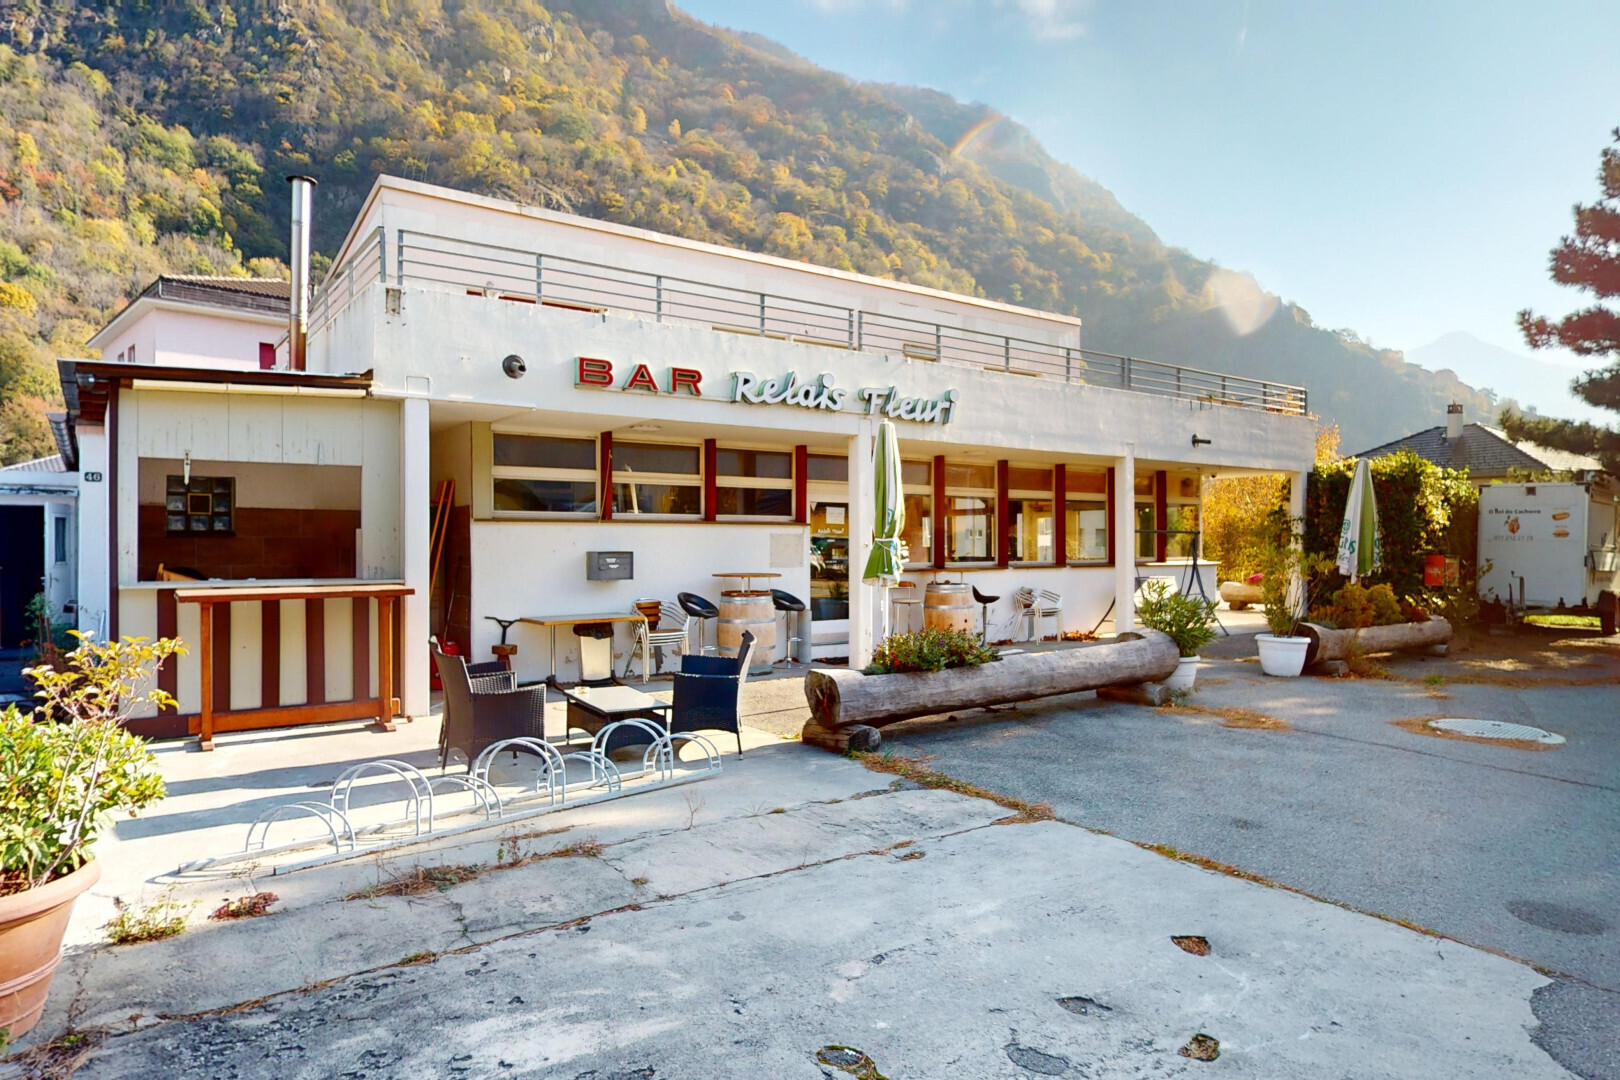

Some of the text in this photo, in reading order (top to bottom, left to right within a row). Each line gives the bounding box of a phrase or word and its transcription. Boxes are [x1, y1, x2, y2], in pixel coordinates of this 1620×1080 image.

[575, 356, 960, 424] BAR Relais Fleuri
